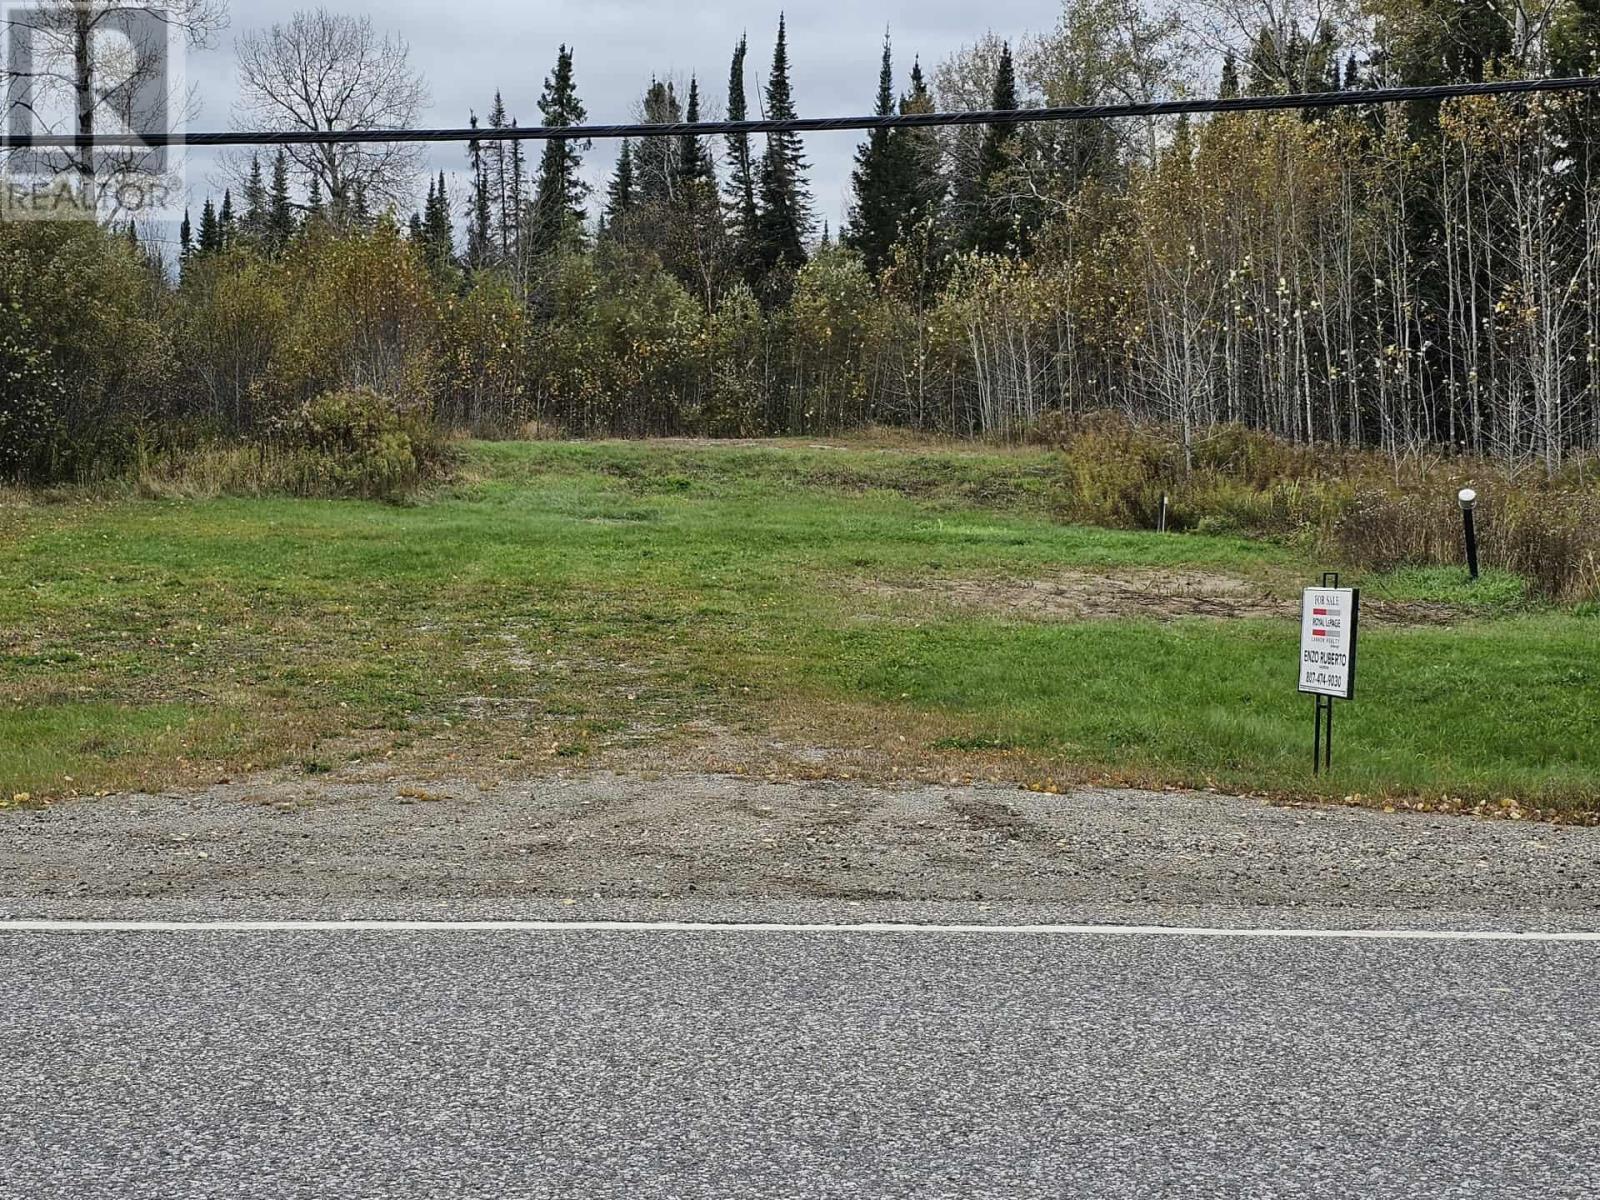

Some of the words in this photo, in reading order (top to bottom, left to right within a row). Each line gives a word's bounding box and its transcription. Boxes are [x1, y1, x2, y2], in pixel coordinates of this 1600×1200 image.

[1314, 595, 1324, 605] FOR
[1326, 596, 1340, 606] SALE
[1312, 618, 1324, 626] ROYAL
[1304, 650, 1318, 663] ENZO
[1320, 652, 1346, 666] RUBERTO
[1306, 672, 1342, 688] 807-474-9030
